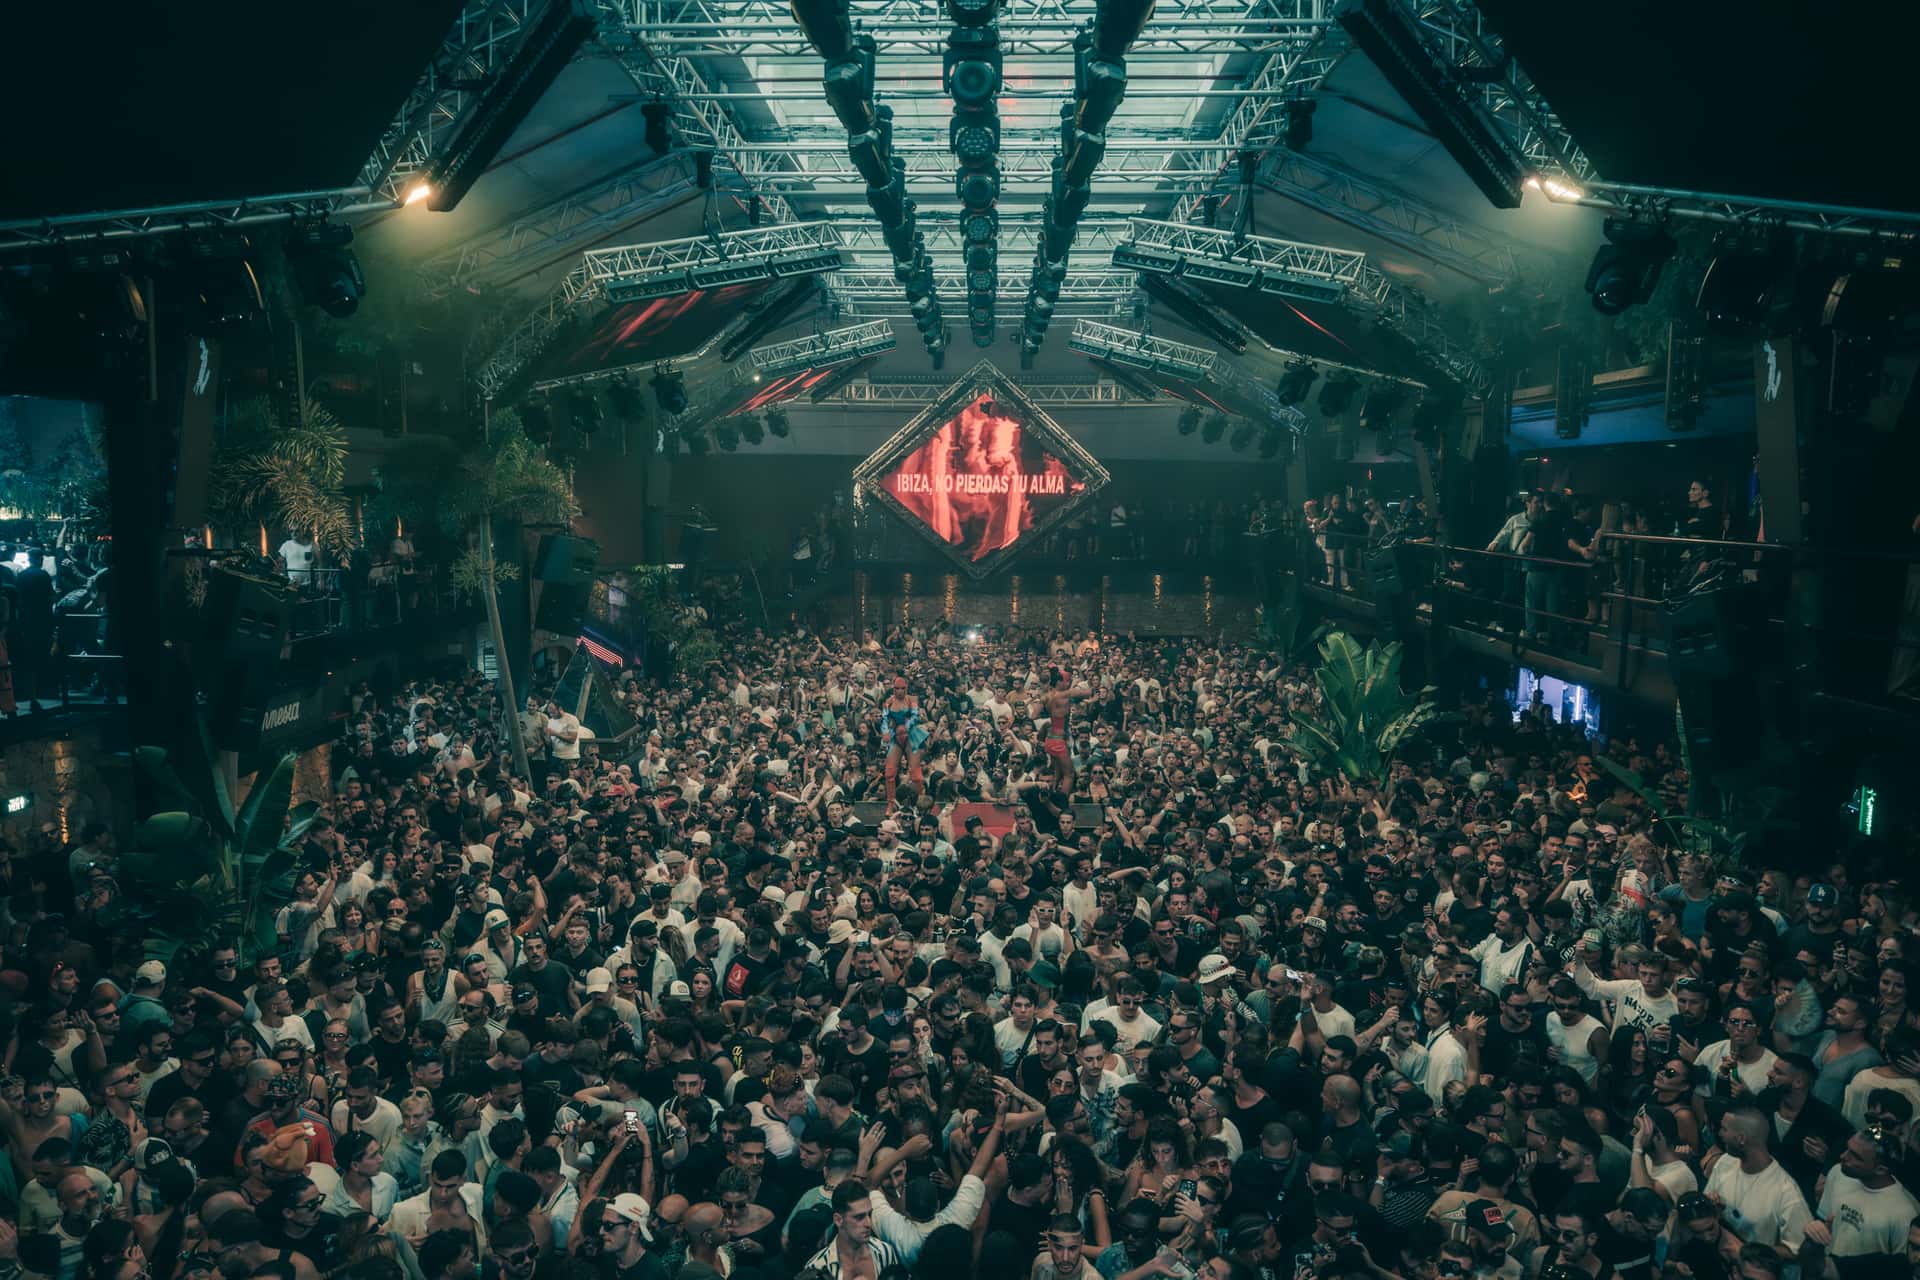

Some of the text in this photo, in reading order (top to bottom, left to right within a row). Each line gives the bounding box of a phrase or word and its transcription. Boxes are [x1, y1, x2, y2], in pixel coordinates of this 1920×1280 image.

[897, 474, 1064, 496] IBIZA, NO PIERDAS TU ALMA
